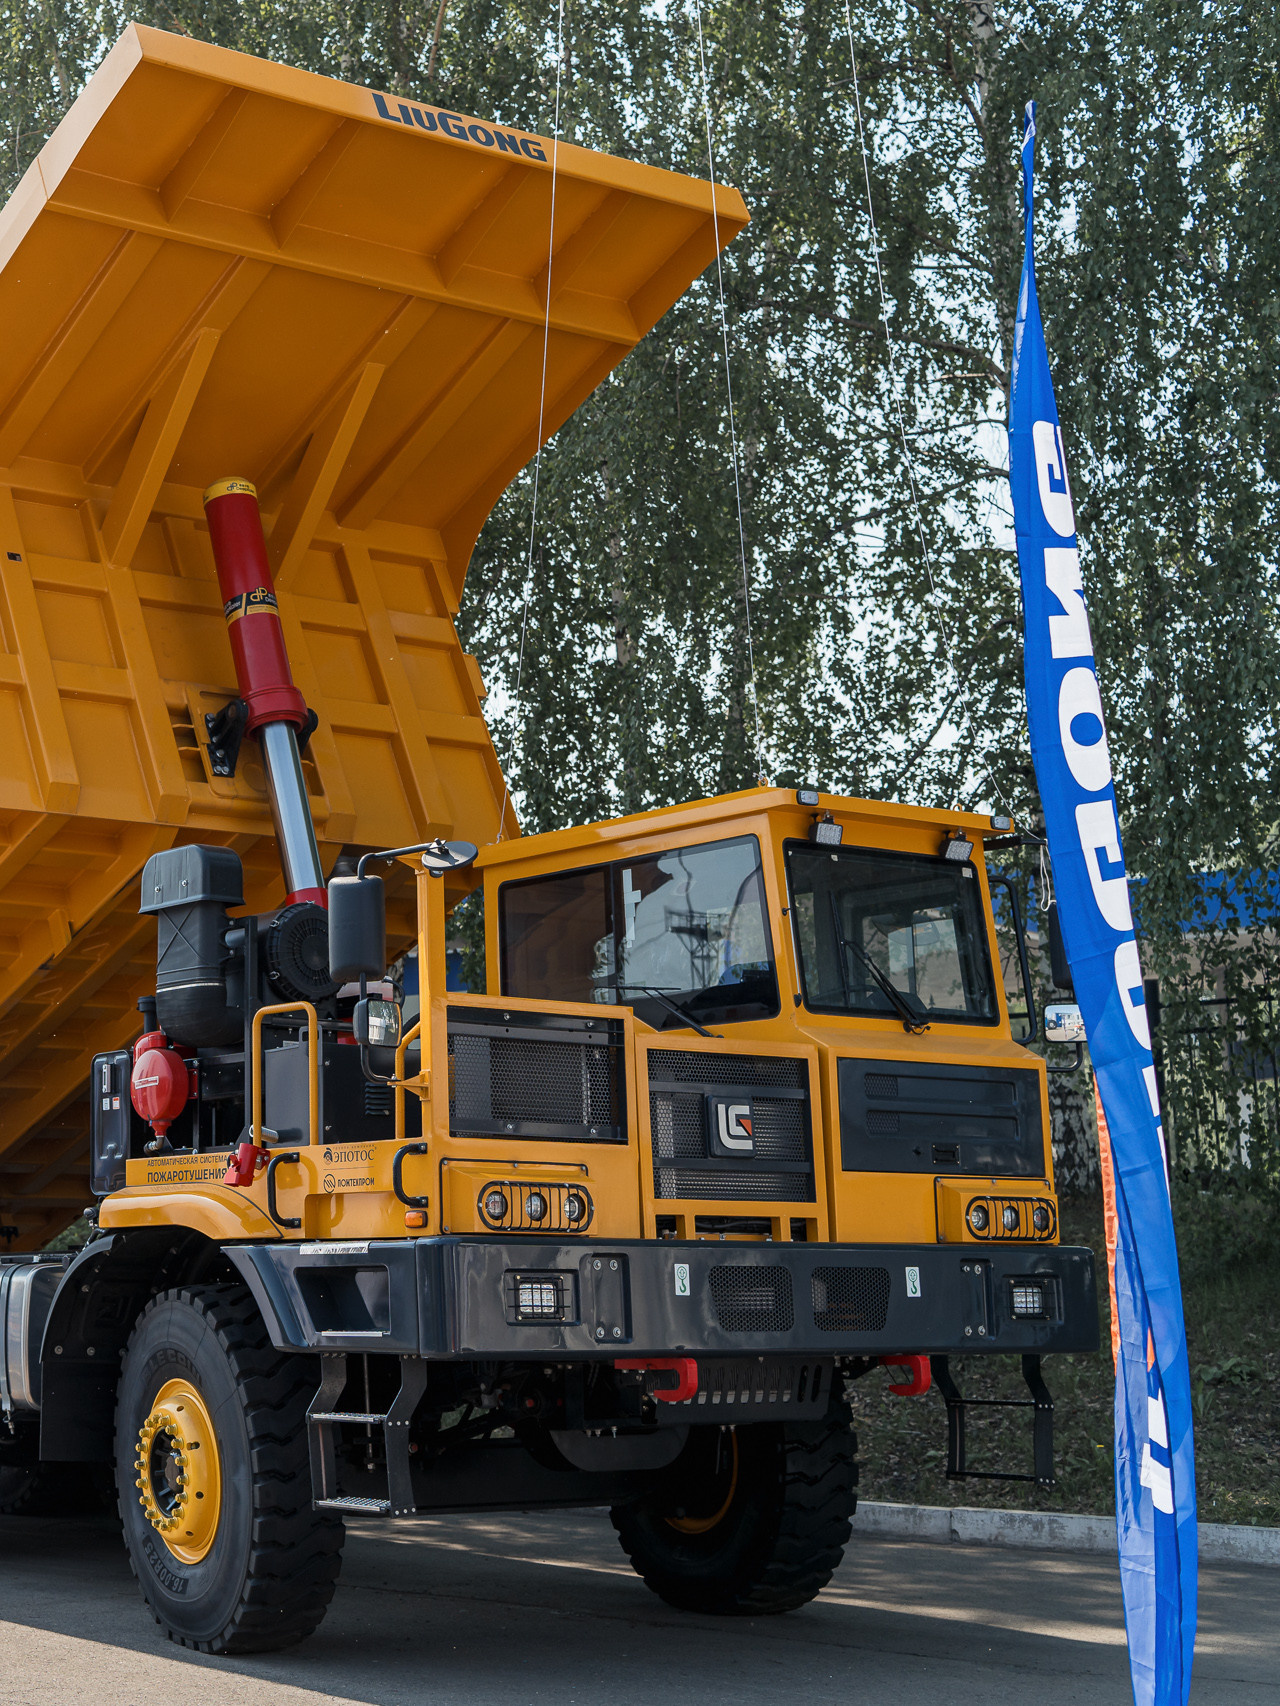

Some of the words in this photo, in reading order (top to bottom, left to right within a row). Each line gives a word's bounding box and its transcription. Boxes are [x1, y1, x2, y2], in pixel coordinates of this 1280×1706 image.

[147, 1157, 198, 1167] АВТОМАТИЧЕСКАЯ
[199, 1155, 228, 1164] СИСТЕМА
[333, 1149, 375, 1163] ЭПОТОС
[147, 1168, 227, 1183] ПОЖАРОТУШЕНИЯ
[337, 1177, 375, 1187] ПОЖТЕХПРОМ
[144, 1542, 184, 1592] 16.00R25
